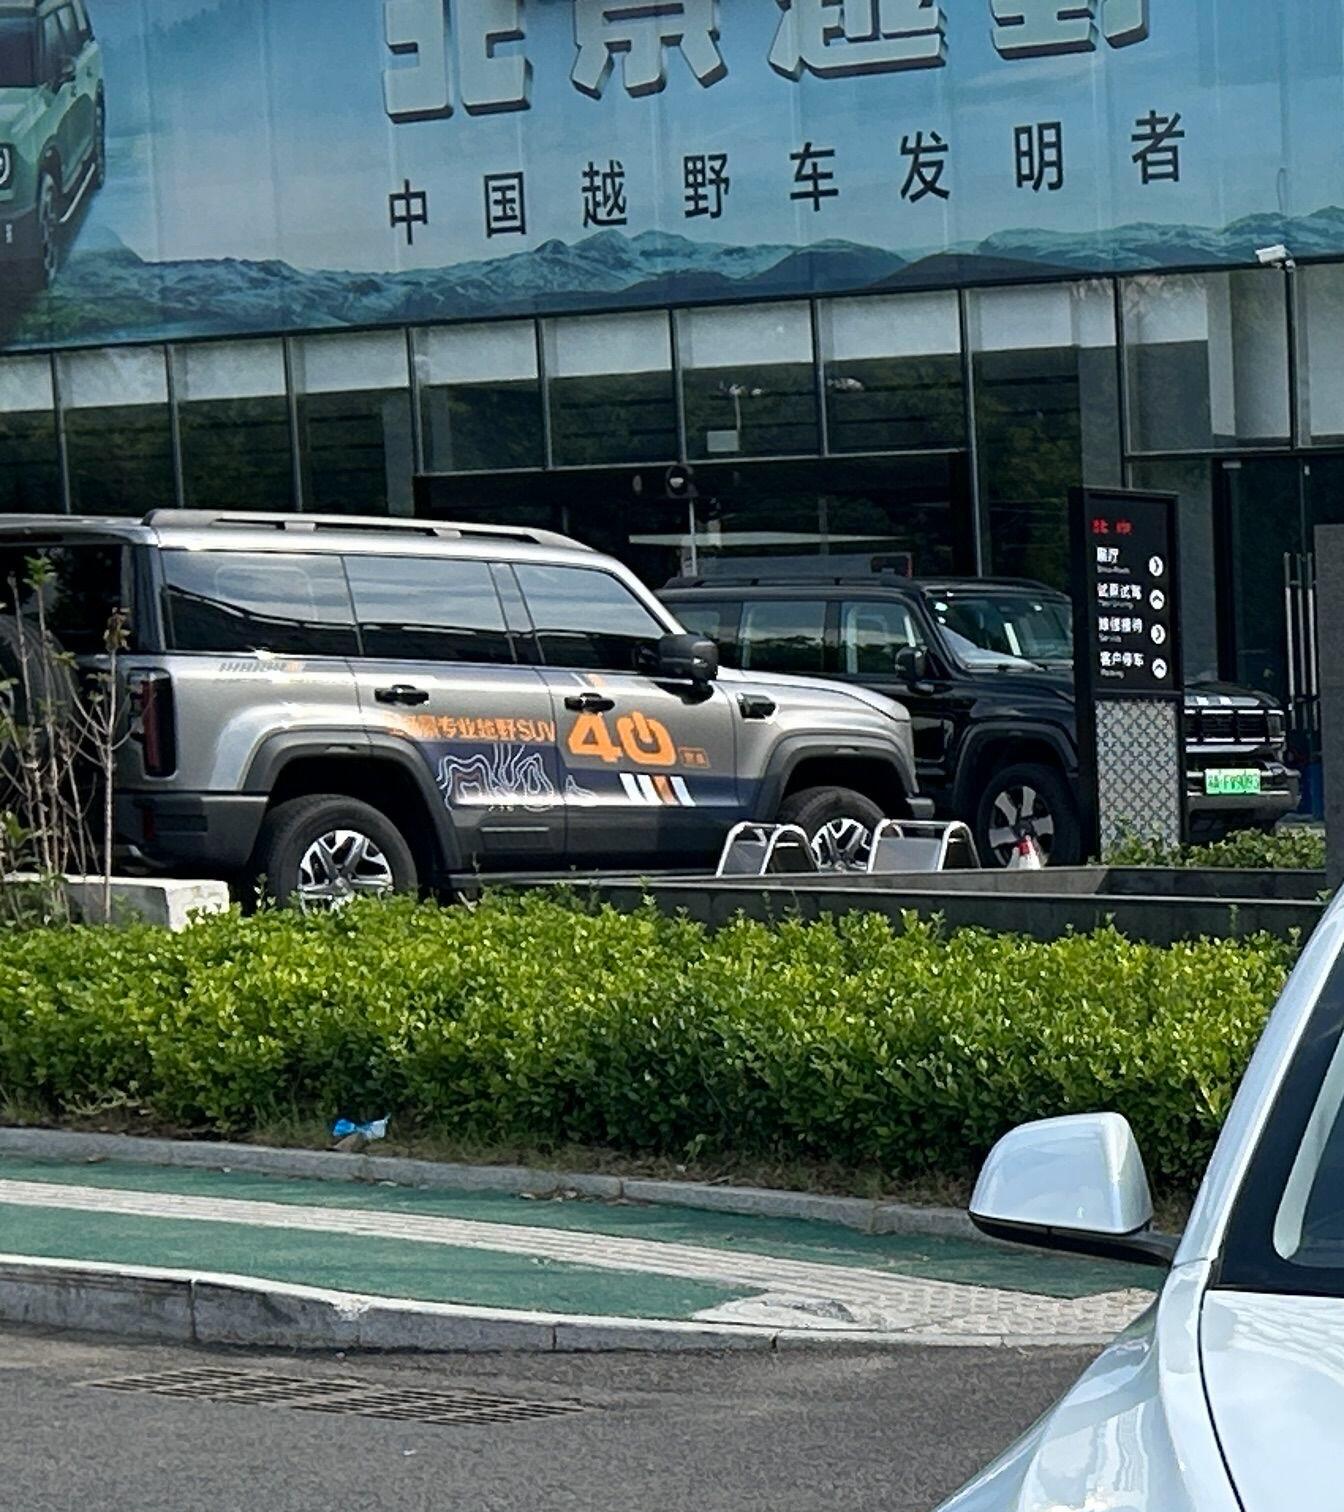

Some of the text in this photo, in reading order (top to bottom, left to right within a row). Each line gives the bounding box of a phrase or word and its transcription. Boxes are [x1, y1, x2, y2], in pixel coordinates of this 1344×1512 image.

[389, 110, 1186, 246] 中国越野车发明者
